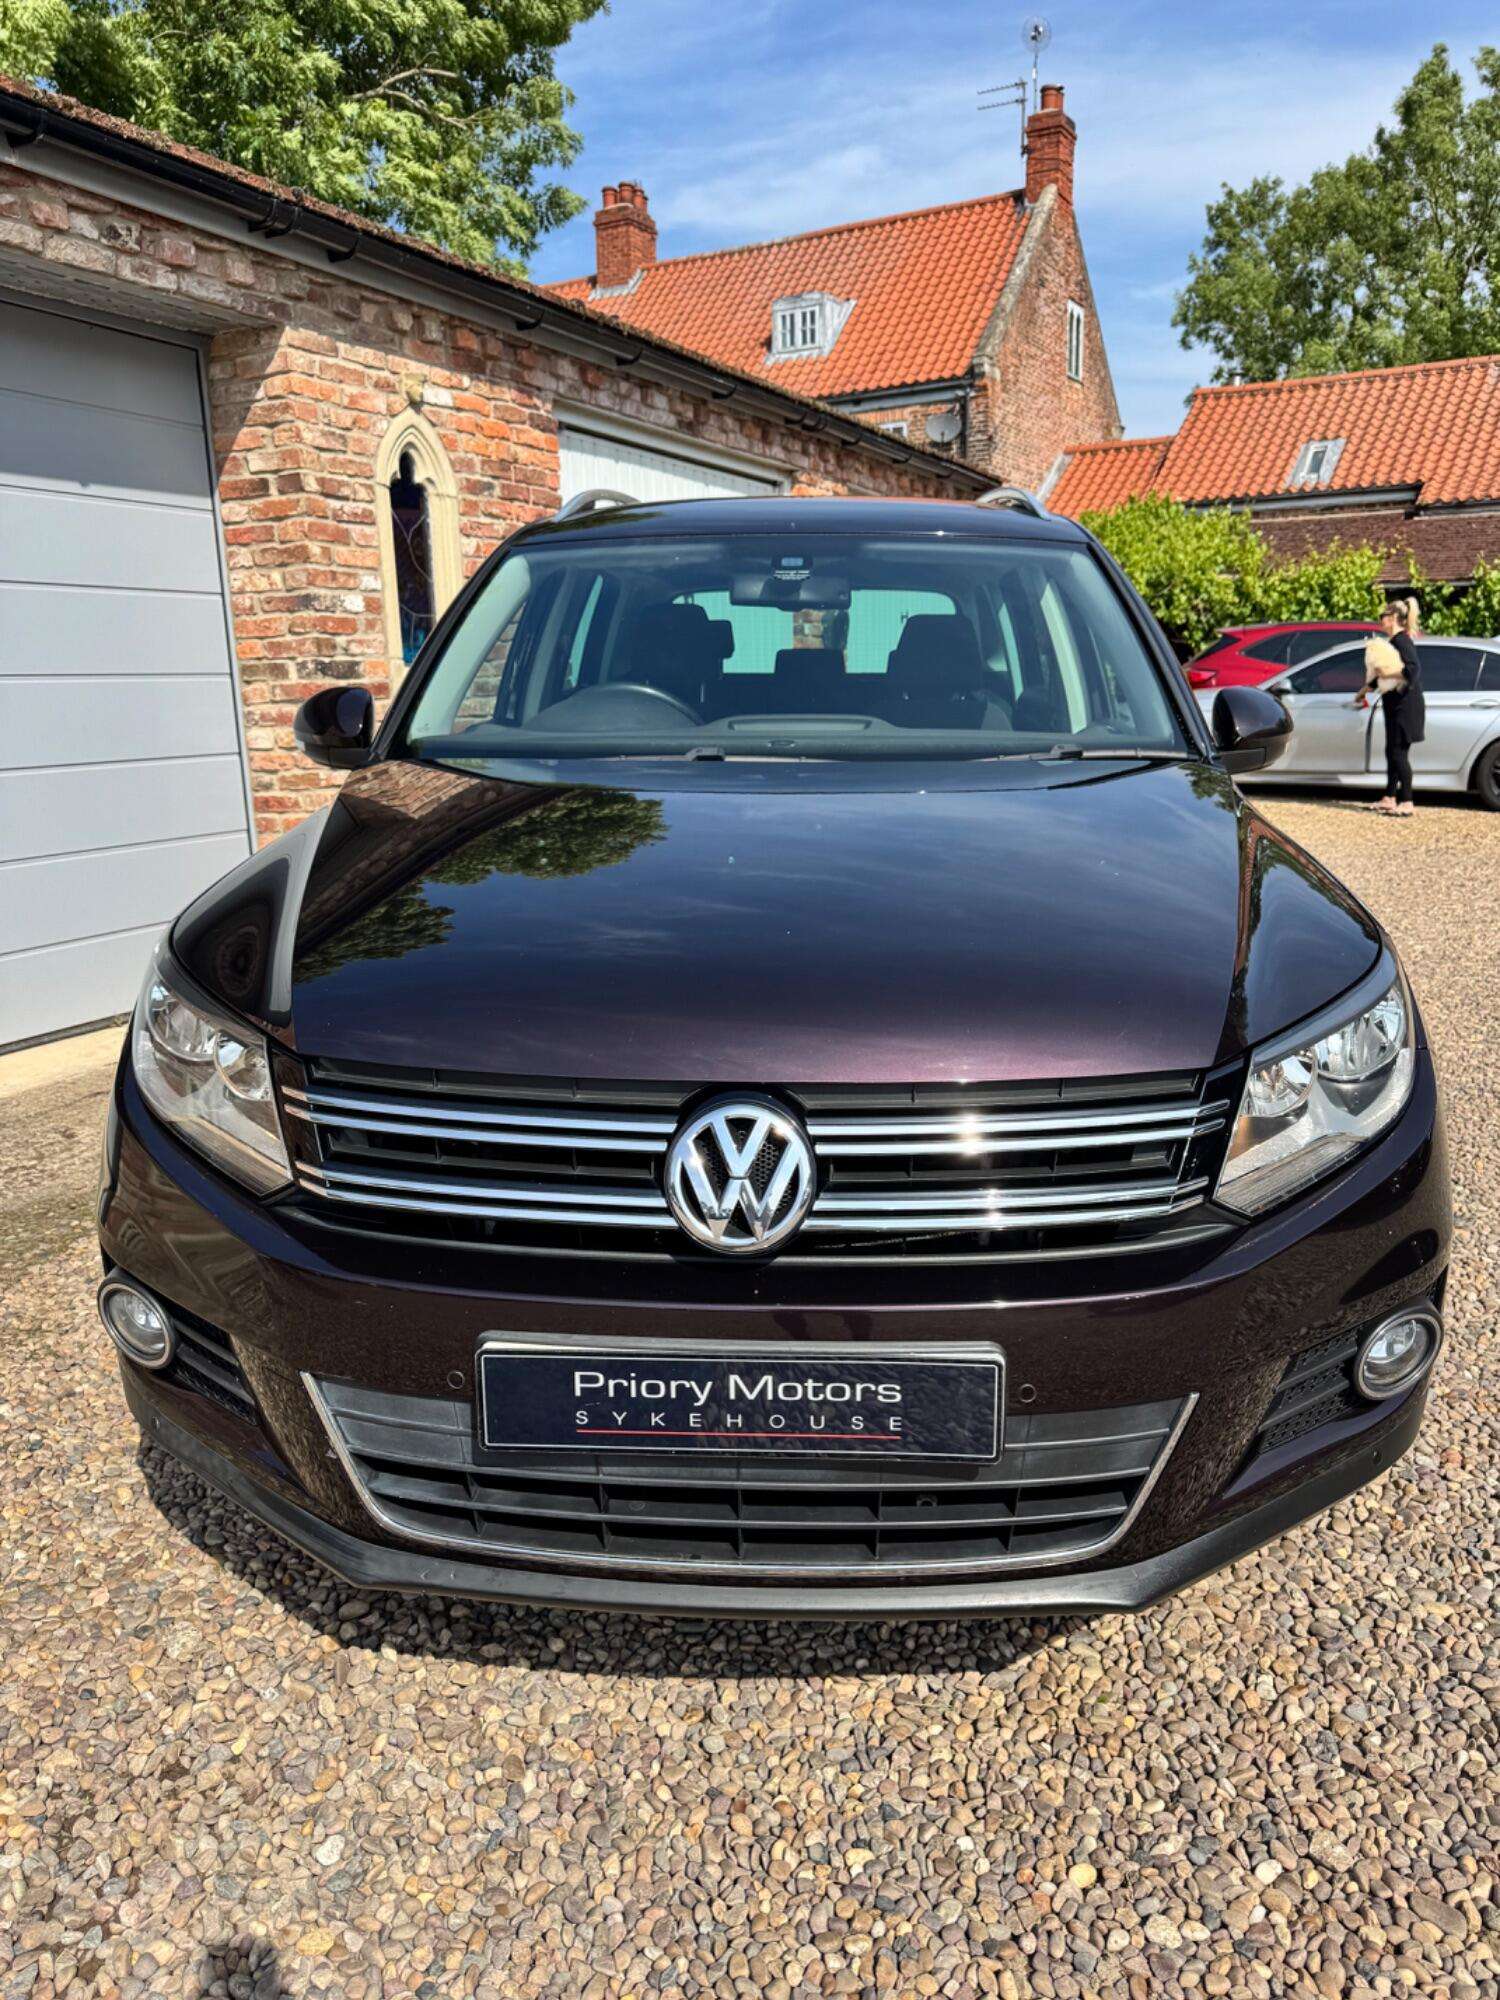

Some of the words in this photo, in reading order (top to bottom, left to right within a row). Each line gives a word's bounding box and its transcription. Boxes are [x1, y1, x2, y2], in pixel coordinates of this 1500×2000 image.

[671, 1105, 812, 1250] VW
[573, 1371, 714, 1407] Priory
[728, 1374, 902, 1403] Motors
[575, 1410, 902, 1432] SYKEHOUSE
